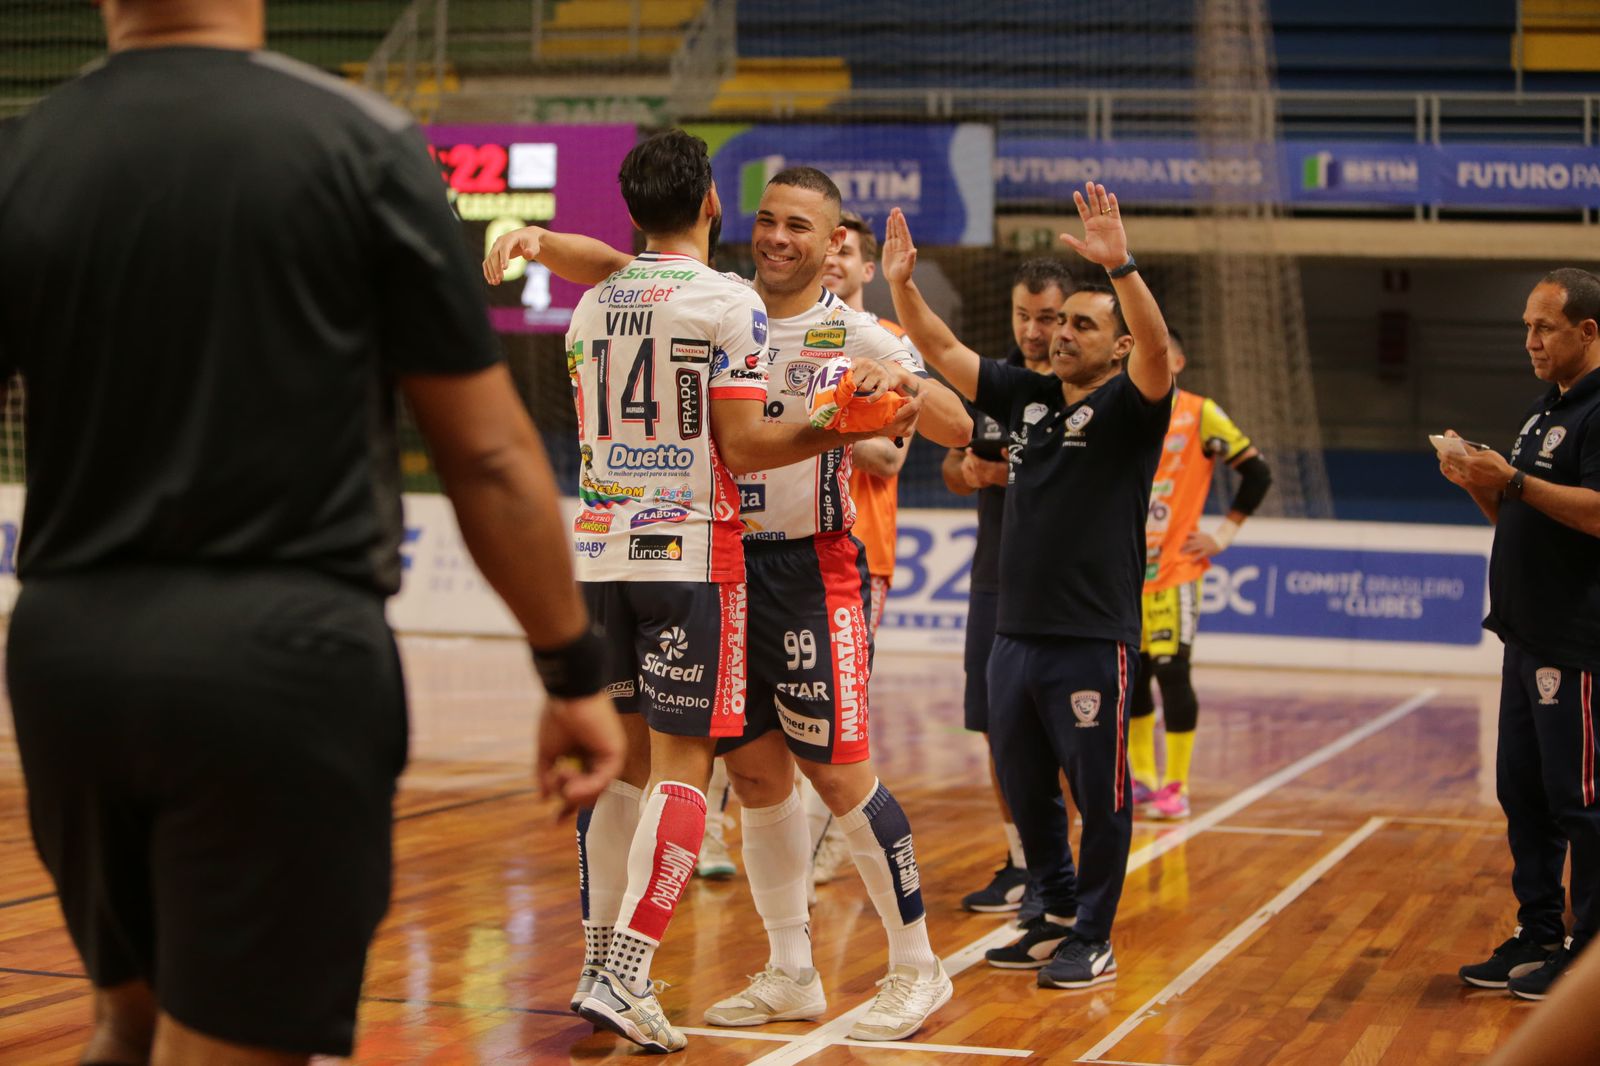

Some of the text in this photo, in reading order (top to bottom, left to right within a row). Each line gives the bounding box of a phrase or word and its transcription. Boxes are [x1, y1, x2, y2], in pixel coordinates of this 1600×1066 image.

[842, 169, 922, 201] ETIM
[1456, 161, 1569, 190] FUTURO
[622, 266, 700, 282] Sicredi
[598, 284, 675, 304] Cleardet
[606, 310, 653, 337] VINI
[592, 338, 660, 440] 14
[680, 374, 693, 435] PRADO
[608, 443, 694, 469] Duetto
[655, 485, 693, 500] Alegria
[637, 510, 681, 520] FLABOM
[630, 538, 681, 560] furioso
[1344, 596, 1423, 619] CLUBES
[731, 582, 747, 715] MUFFATÃO
[784, 629, 817, 671] 99
[641, 652, 705, 683] Sicredi
[831, 607, 859, 742] MUFFATÃO
[657, 692, 710, 709] CARDIO
[776, 681, 830, 701] STAR
